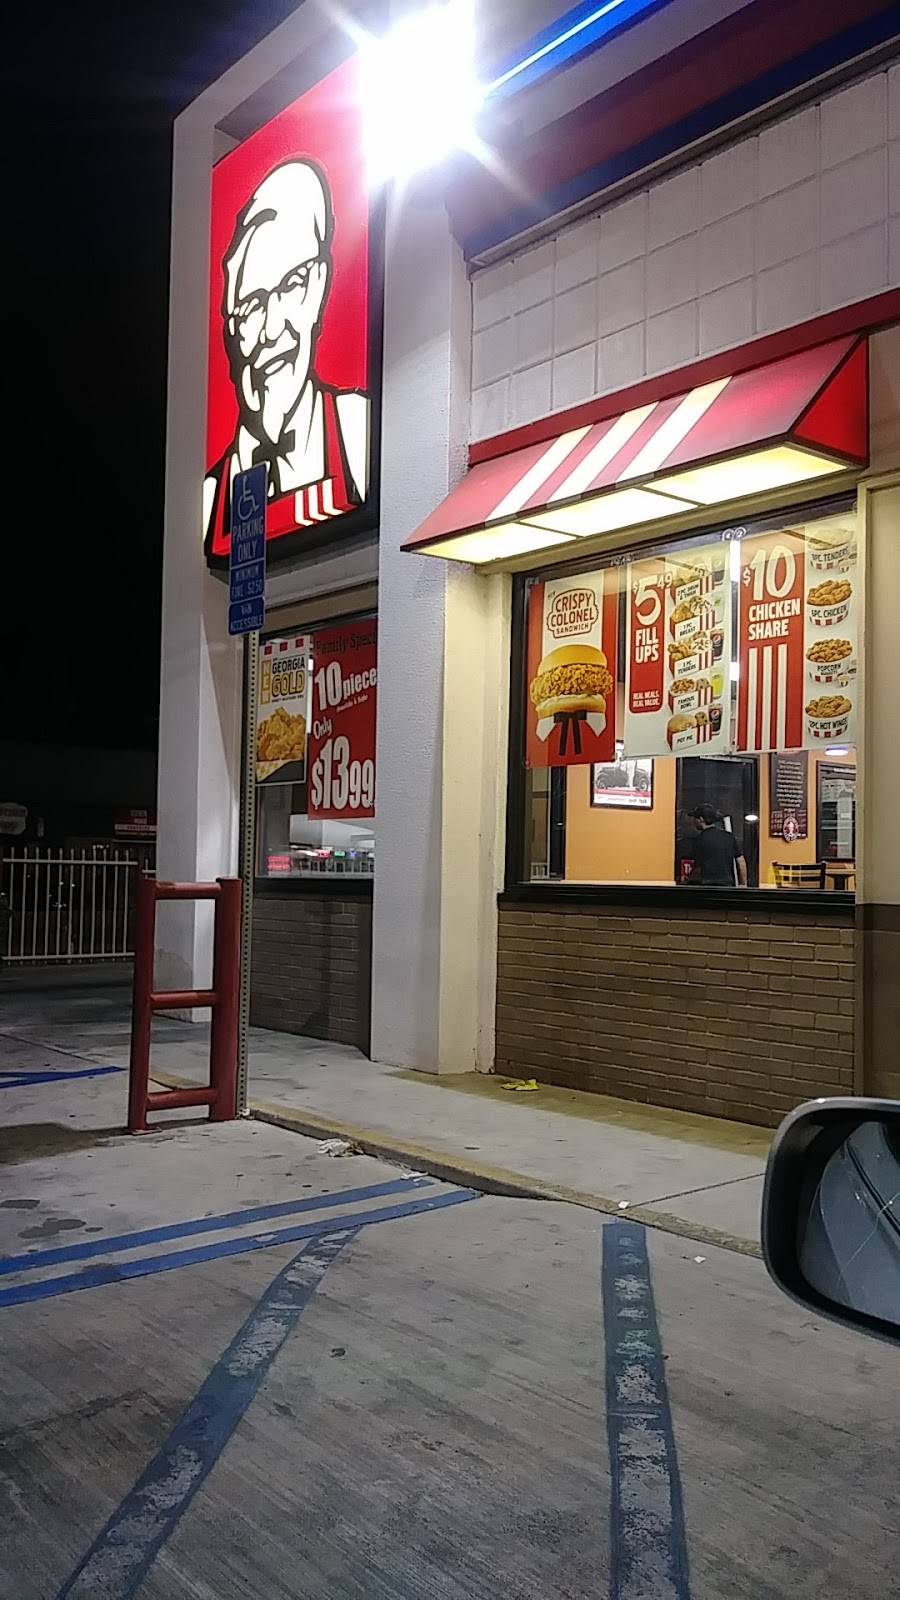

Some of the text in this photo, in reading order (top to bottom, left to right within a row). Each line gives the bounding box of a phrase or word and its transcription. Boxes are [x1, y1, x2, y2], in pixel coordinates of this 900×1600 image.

[232, 516, 264, 544] PARKING
[238, 539, 257, 562] ONLY
[824, 546, 848, 562] TENDERS
[236, 564, 260, 582] MINIMUM
[743, 545, 796, 601] $10
[231, 579, 262, 600] FINE $250
[556, 593, 592, 612] CRISPY
[749, 598, 800, 622] CHICKEN
[824, 605, 847, 618] CHICKEN
[231, 615, 263, 631] ACCESSIBLE
[551, 608, 594, 628] COLONEL
[556, 623, 589, 634] SANDWICH
[635, 626, 659, 647] FILL
[680, 626, 696, 636] BREAST
[748, 619, 789, 641] SHARE
[316, 636, 346, 656] Family
[635, 644, 659, 664] UPS
[272, 656, 305, 674] GEORGIA
[817, 662, 841, 671] POPCORN
[272, 670, 306, 698] GOLD
[315, 661, 342, 711] 10
[342, 668, 377, 699] piece
[678, 696, 694, 704] FAMOUS
[680, 702, 692, 710] BOWL
[313, 716, 332, 740] Only
[832, 717, 848, 728] WINGS
